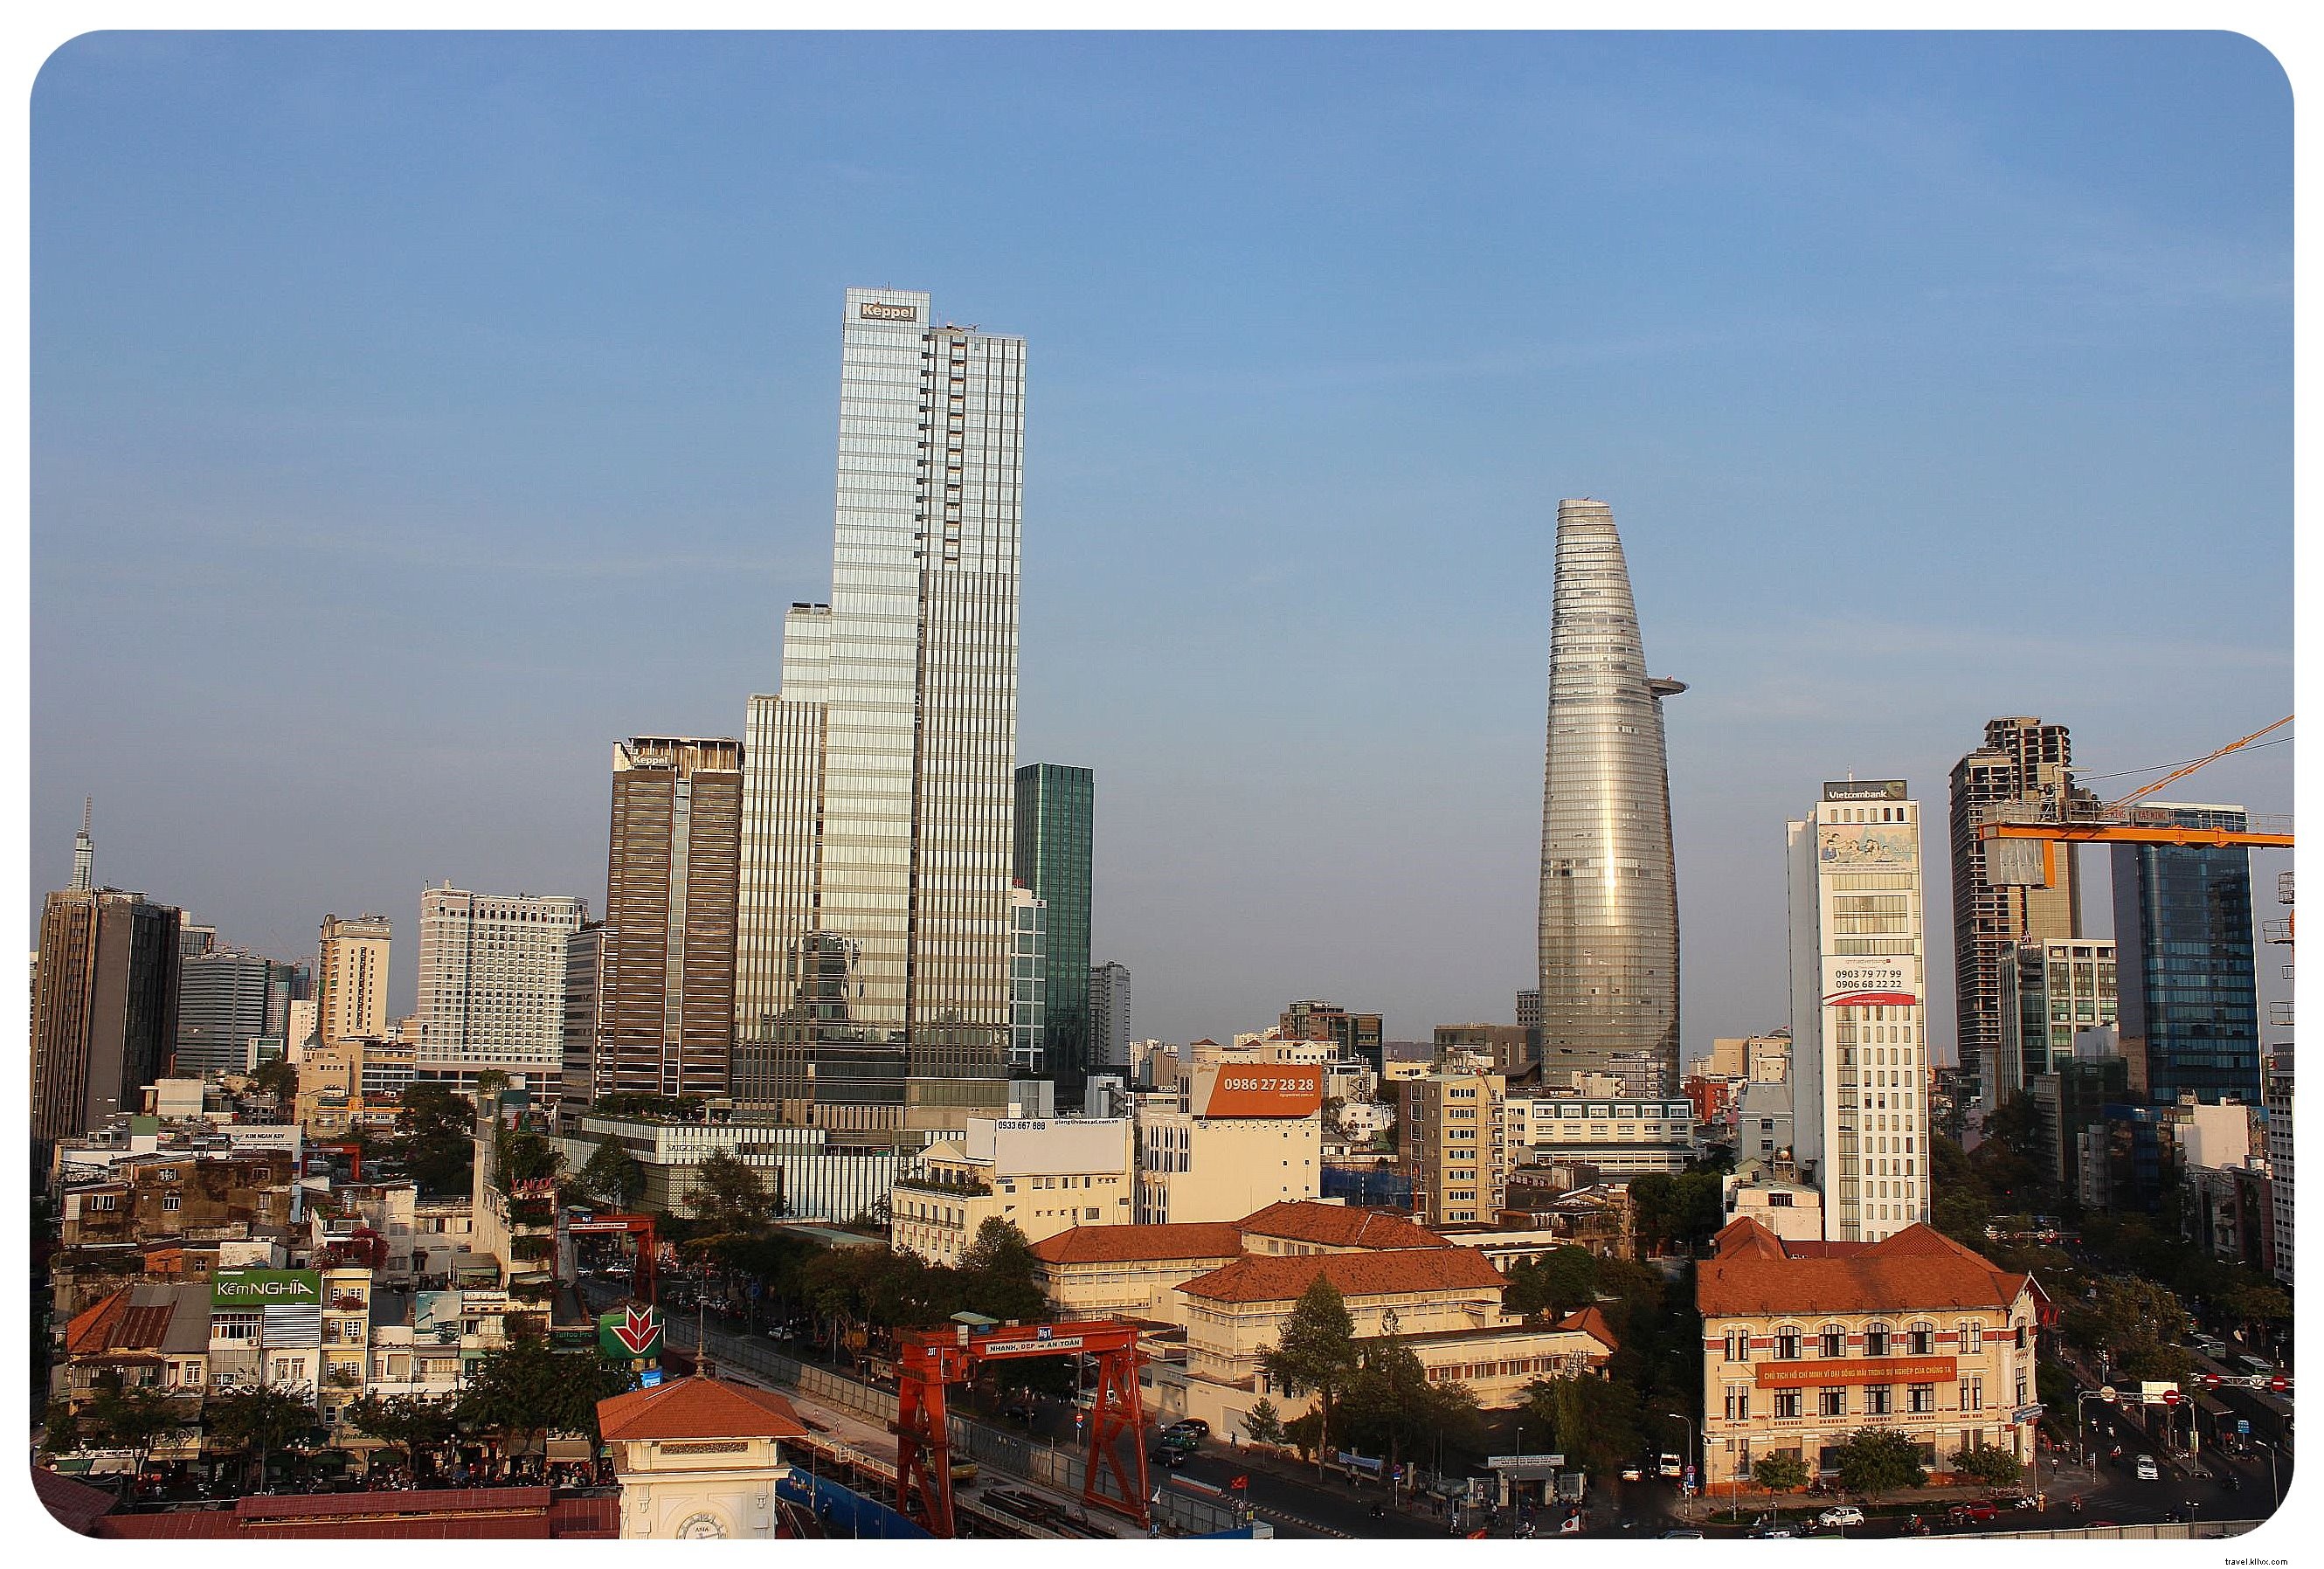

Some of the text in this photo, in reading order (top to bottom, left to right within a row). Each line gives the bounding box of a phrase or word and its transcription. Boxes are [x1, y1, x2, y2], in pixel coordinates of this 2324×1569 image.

[862, 304, 915, 319] Keppel
[633, 755, 668, 765] Keppel
[1829, 790, 1887, 799] Vietcombank
[1836, 970, 1859, 978] 0903
[1862, 970, 1874, 978] 79
[1224, 1078, 1314, 1091] 0986 27 28 28
[1017, 1121, 1031, 1130] 667
[1033, 1121, 1046, 1130] 888
